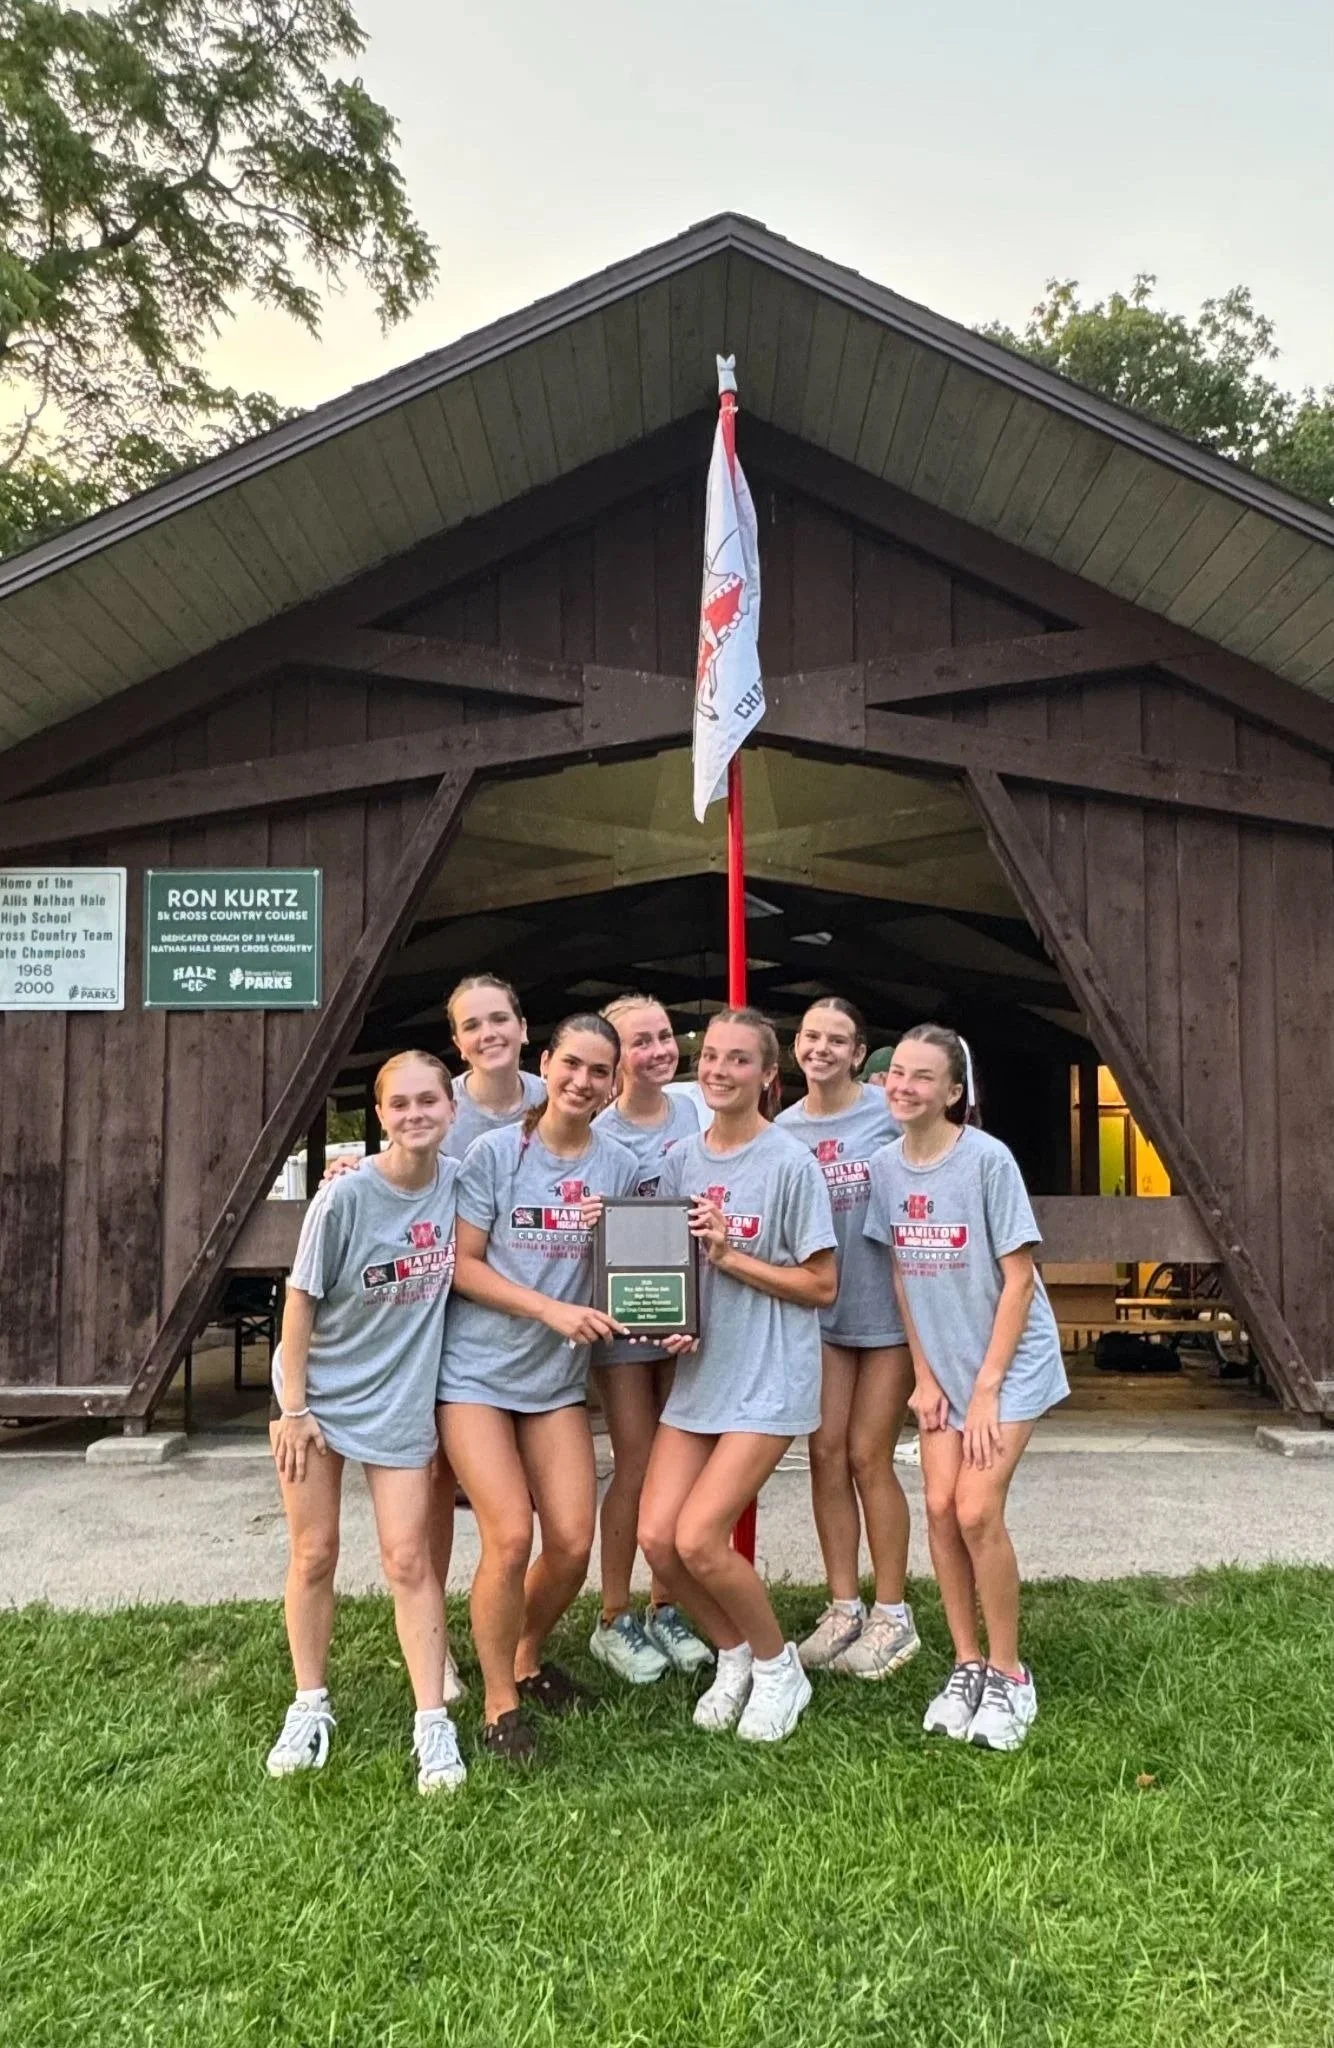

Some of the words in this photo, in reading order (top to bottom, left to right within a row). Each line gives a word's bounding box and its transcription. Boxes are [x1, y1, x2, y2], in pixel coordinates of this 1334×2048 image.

[733, 677, 764, 720] CHA
[0, 877, 32, 889] Home
[37, 877, 49, 889] of
[55, 877, 73, 889] the
[2, 895, 28, 907] Allis
[33, 895, 75, 907] Nathan
[80, 895, 106, 907] Hale
[168, 888, 217, 907] RON
[224, 888, 299, 907] KURTZ
[1, 912, 27, 926] High
[32, 911, 72, 924] School
[172, 911, 207, 921] CROSS
[210, 911, 263, 921] COUNTRY
[264, 911, 308, 921] COURSE
[31, 929, 77, 943] Country
[83, 929, 113, 942] Team
[161, 934, 207, 942] DEDICATED
[210, 934, 240, 942] COACH
[242, 934, 253, 942] OF
[267, 934, 295, 942] YEARS
[22, 947, 86, 960] Champions
[151, 944, 187, 953] NATHAN
[189, 944, 211, 953] HALE
[213, 944, 239, 953] MEN'S
[241, 944, 269, 953] CROSS
[271, 944, 313, 953] COUNTRY
[18, 964, 53, 976] 1968
[172, 965, 217, 981] HALE
[14, 981, 54, 994] 2000
[244, 976, 293, 990] PARKS
[80, 990, 116, 999] PARKS
[898, 1226, 960, 1239] HAMILTON
